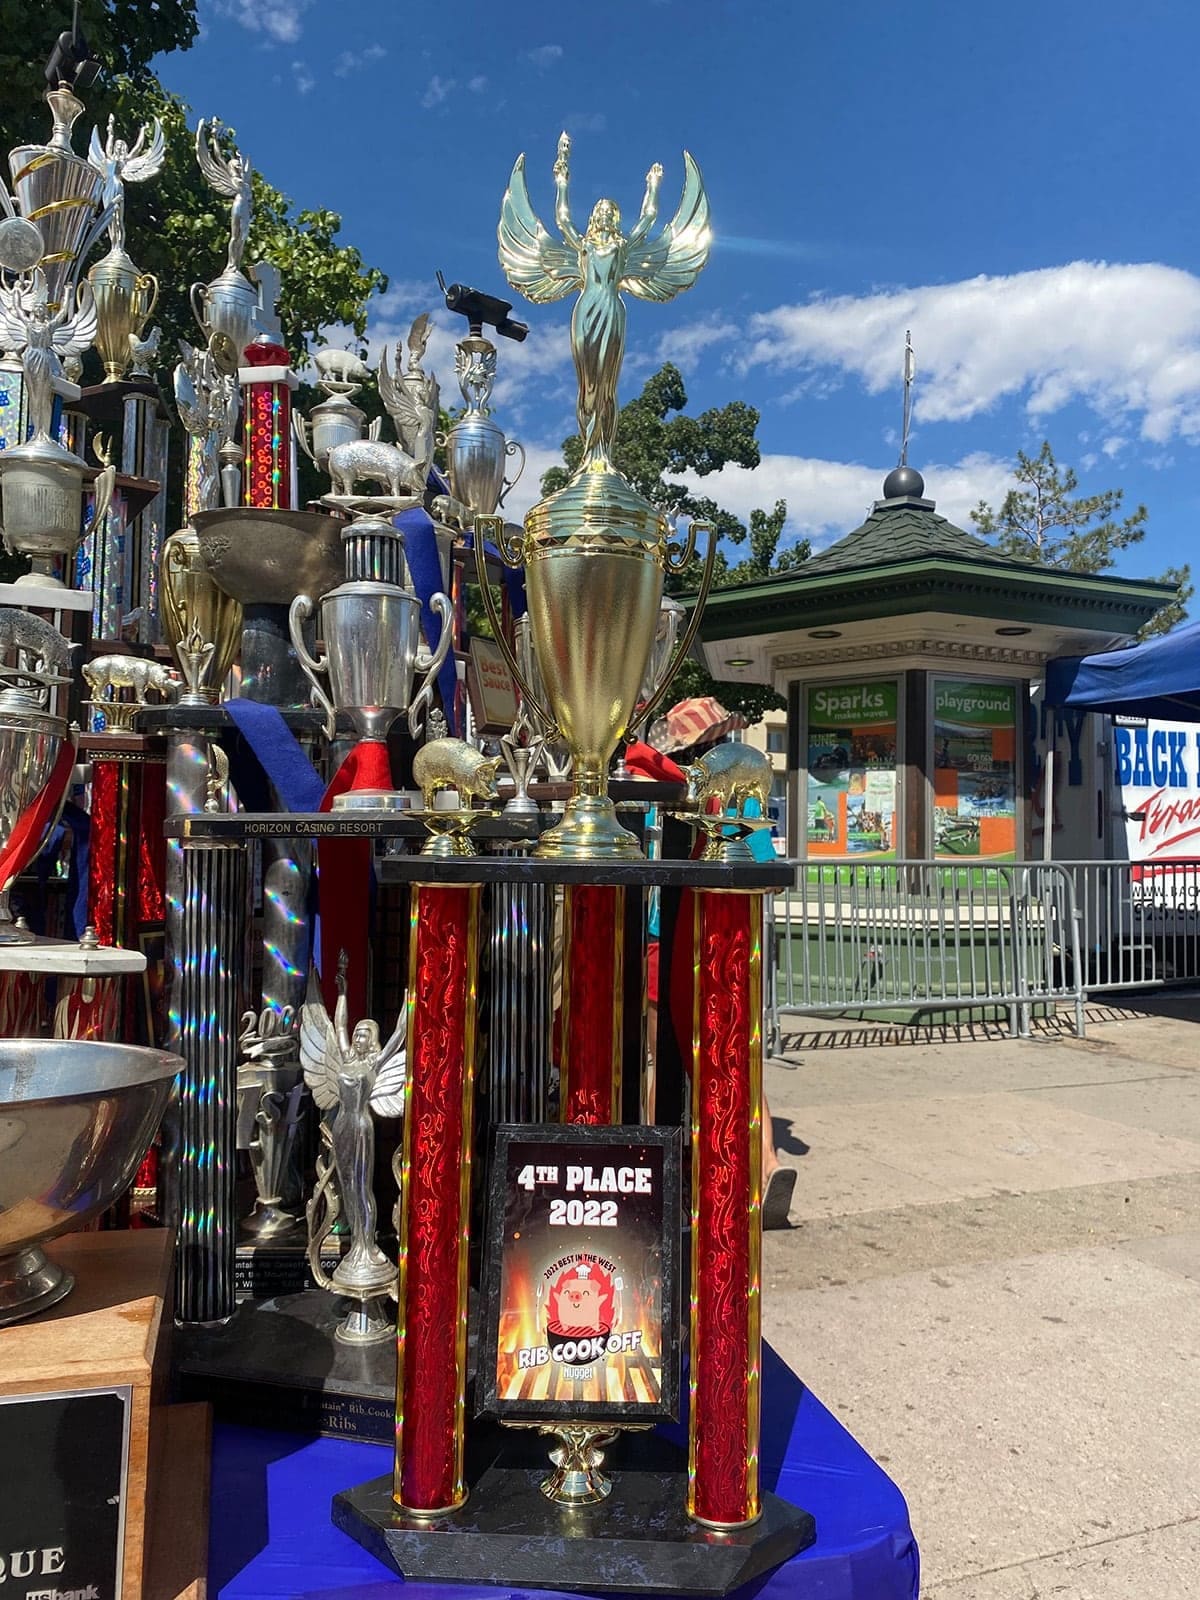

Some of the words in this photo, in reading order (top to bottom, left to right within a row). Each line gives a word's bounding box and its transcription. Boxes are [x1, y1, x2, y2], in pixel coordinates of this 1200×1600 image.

[814, 687, 884, 716] Sparks
[935, 691, 1011, 713] playground
[834, 710, 861, 720] makes
[863, 710, 889, 718] waves
[1115, 726, 1188, 788] BACK
[244, 823, 291, 833] HORIZON
[295, 822, 336, 833] CASINO
[339, 823, 384, 833] RESORT
[517, 1164, 559, 1191] 4TH
[566, 1166, 653, 1194] PLACE
[549, 1199, 618, 1227] 2022
[558, 1254, 575, 1268] BEST
[575, 1254, 583, 1262] IN
[584, 1253, 597, 1264] THE
[598, 1257, 617, 1274] WEST
[518, 1346, 549, 1369] RIB
[552, 1336, 606, 1364] COOK
[606, 1330, 642, 1353] OFF
[349, 1403, 366, 1415] Rib
